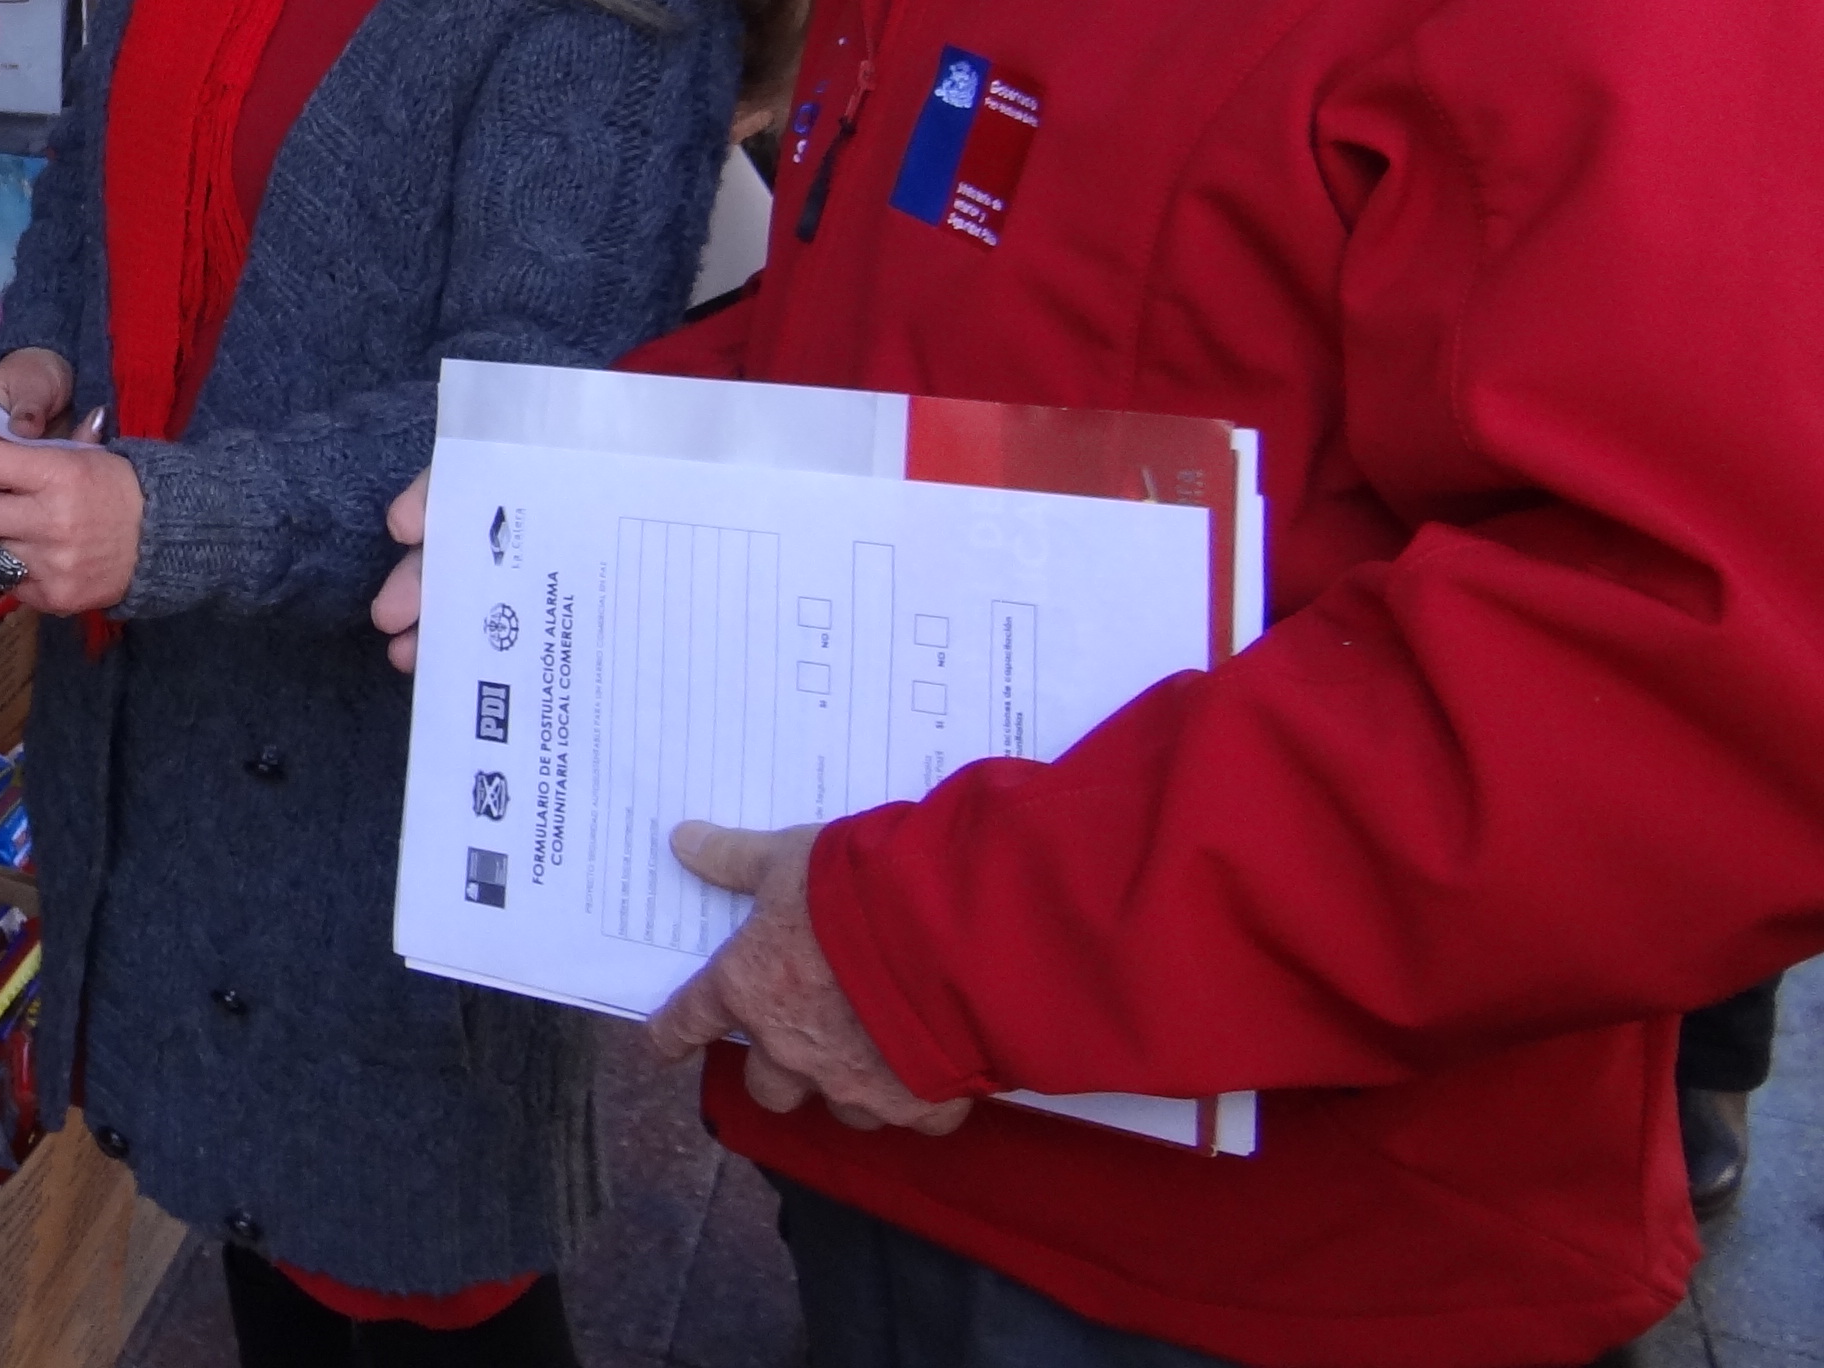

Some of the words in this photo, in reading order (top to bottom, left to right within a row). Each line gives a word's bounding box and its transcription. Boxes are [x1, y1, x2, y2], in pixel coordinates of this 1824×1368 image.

[544, 571, 559, 638] ALARMA
[559, 594, 575, 689] COMERCIAL
[938, 652, 946, 668] NO
[479, 685, 508, 740] PDI
[540, 641, 556, 752] POSTULACIÓN
[556, 695, 570, 747] LOCAL
[538, 755, 551, 776] DE
[532, 781, 550, 885] FORMULARIO
[550, 752, 569, 867] COMUNITARIA
